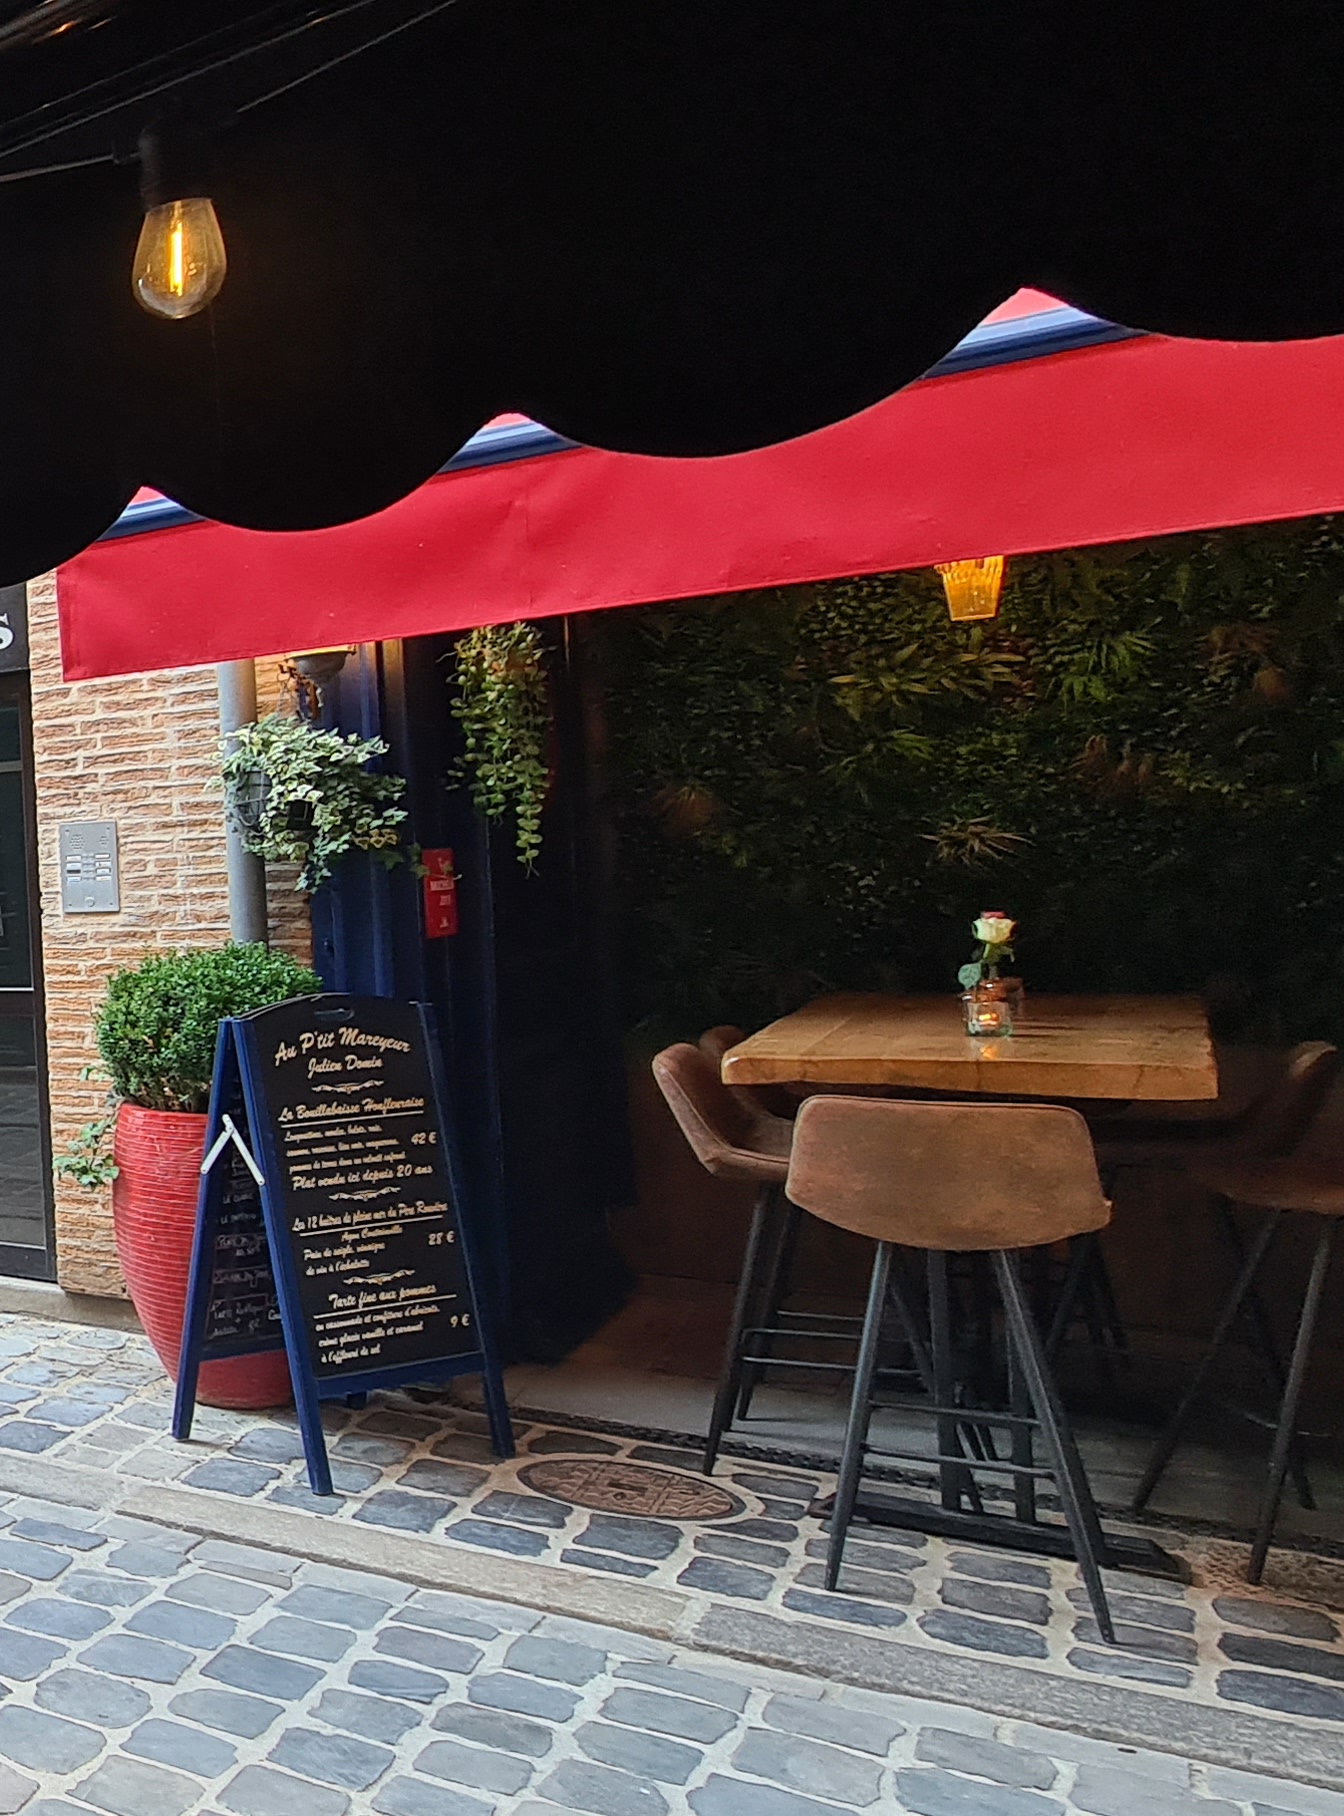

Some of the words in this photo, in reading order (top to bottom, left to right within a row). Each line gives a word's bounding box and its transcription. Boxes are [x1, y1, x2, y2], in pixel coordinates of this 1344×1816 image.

[274, 1041, 297, 1066] Au
[299, 1030, 336, 1054] P'tit
[338, 1026, 411, 1053] Mareyeur
[307, 1057, 343, 1079] Julien
[345, 1055, 384, 1071] Domin
[278, 1107, 294, 1122] La
[410, 1133, 426, 1145] 42
[428, 1131, 437, 1144] €
[291, 1175, 316, 1191] Plat
[317, 1173, 346, 1187] vendu
[348, 1171, 361, 1183] ici
[362, 1168, 394, 1185] depuis
[396, 1164, 413, 1178] 20
[414, 1165, 433, 1175] ans
[306, 1215, 318, 1229] 12
[446, 1230, 455, 1244] €
[328, 1293, 356, 1309] Tarte
[358, 1291, 377, 1309] fine
[378, 1292, 397, 1301] aux
[399, 1284, 437, 1301] pommes
[450, 1315, 457, 1328] 9
[461, 1313, 470, 1327] €
